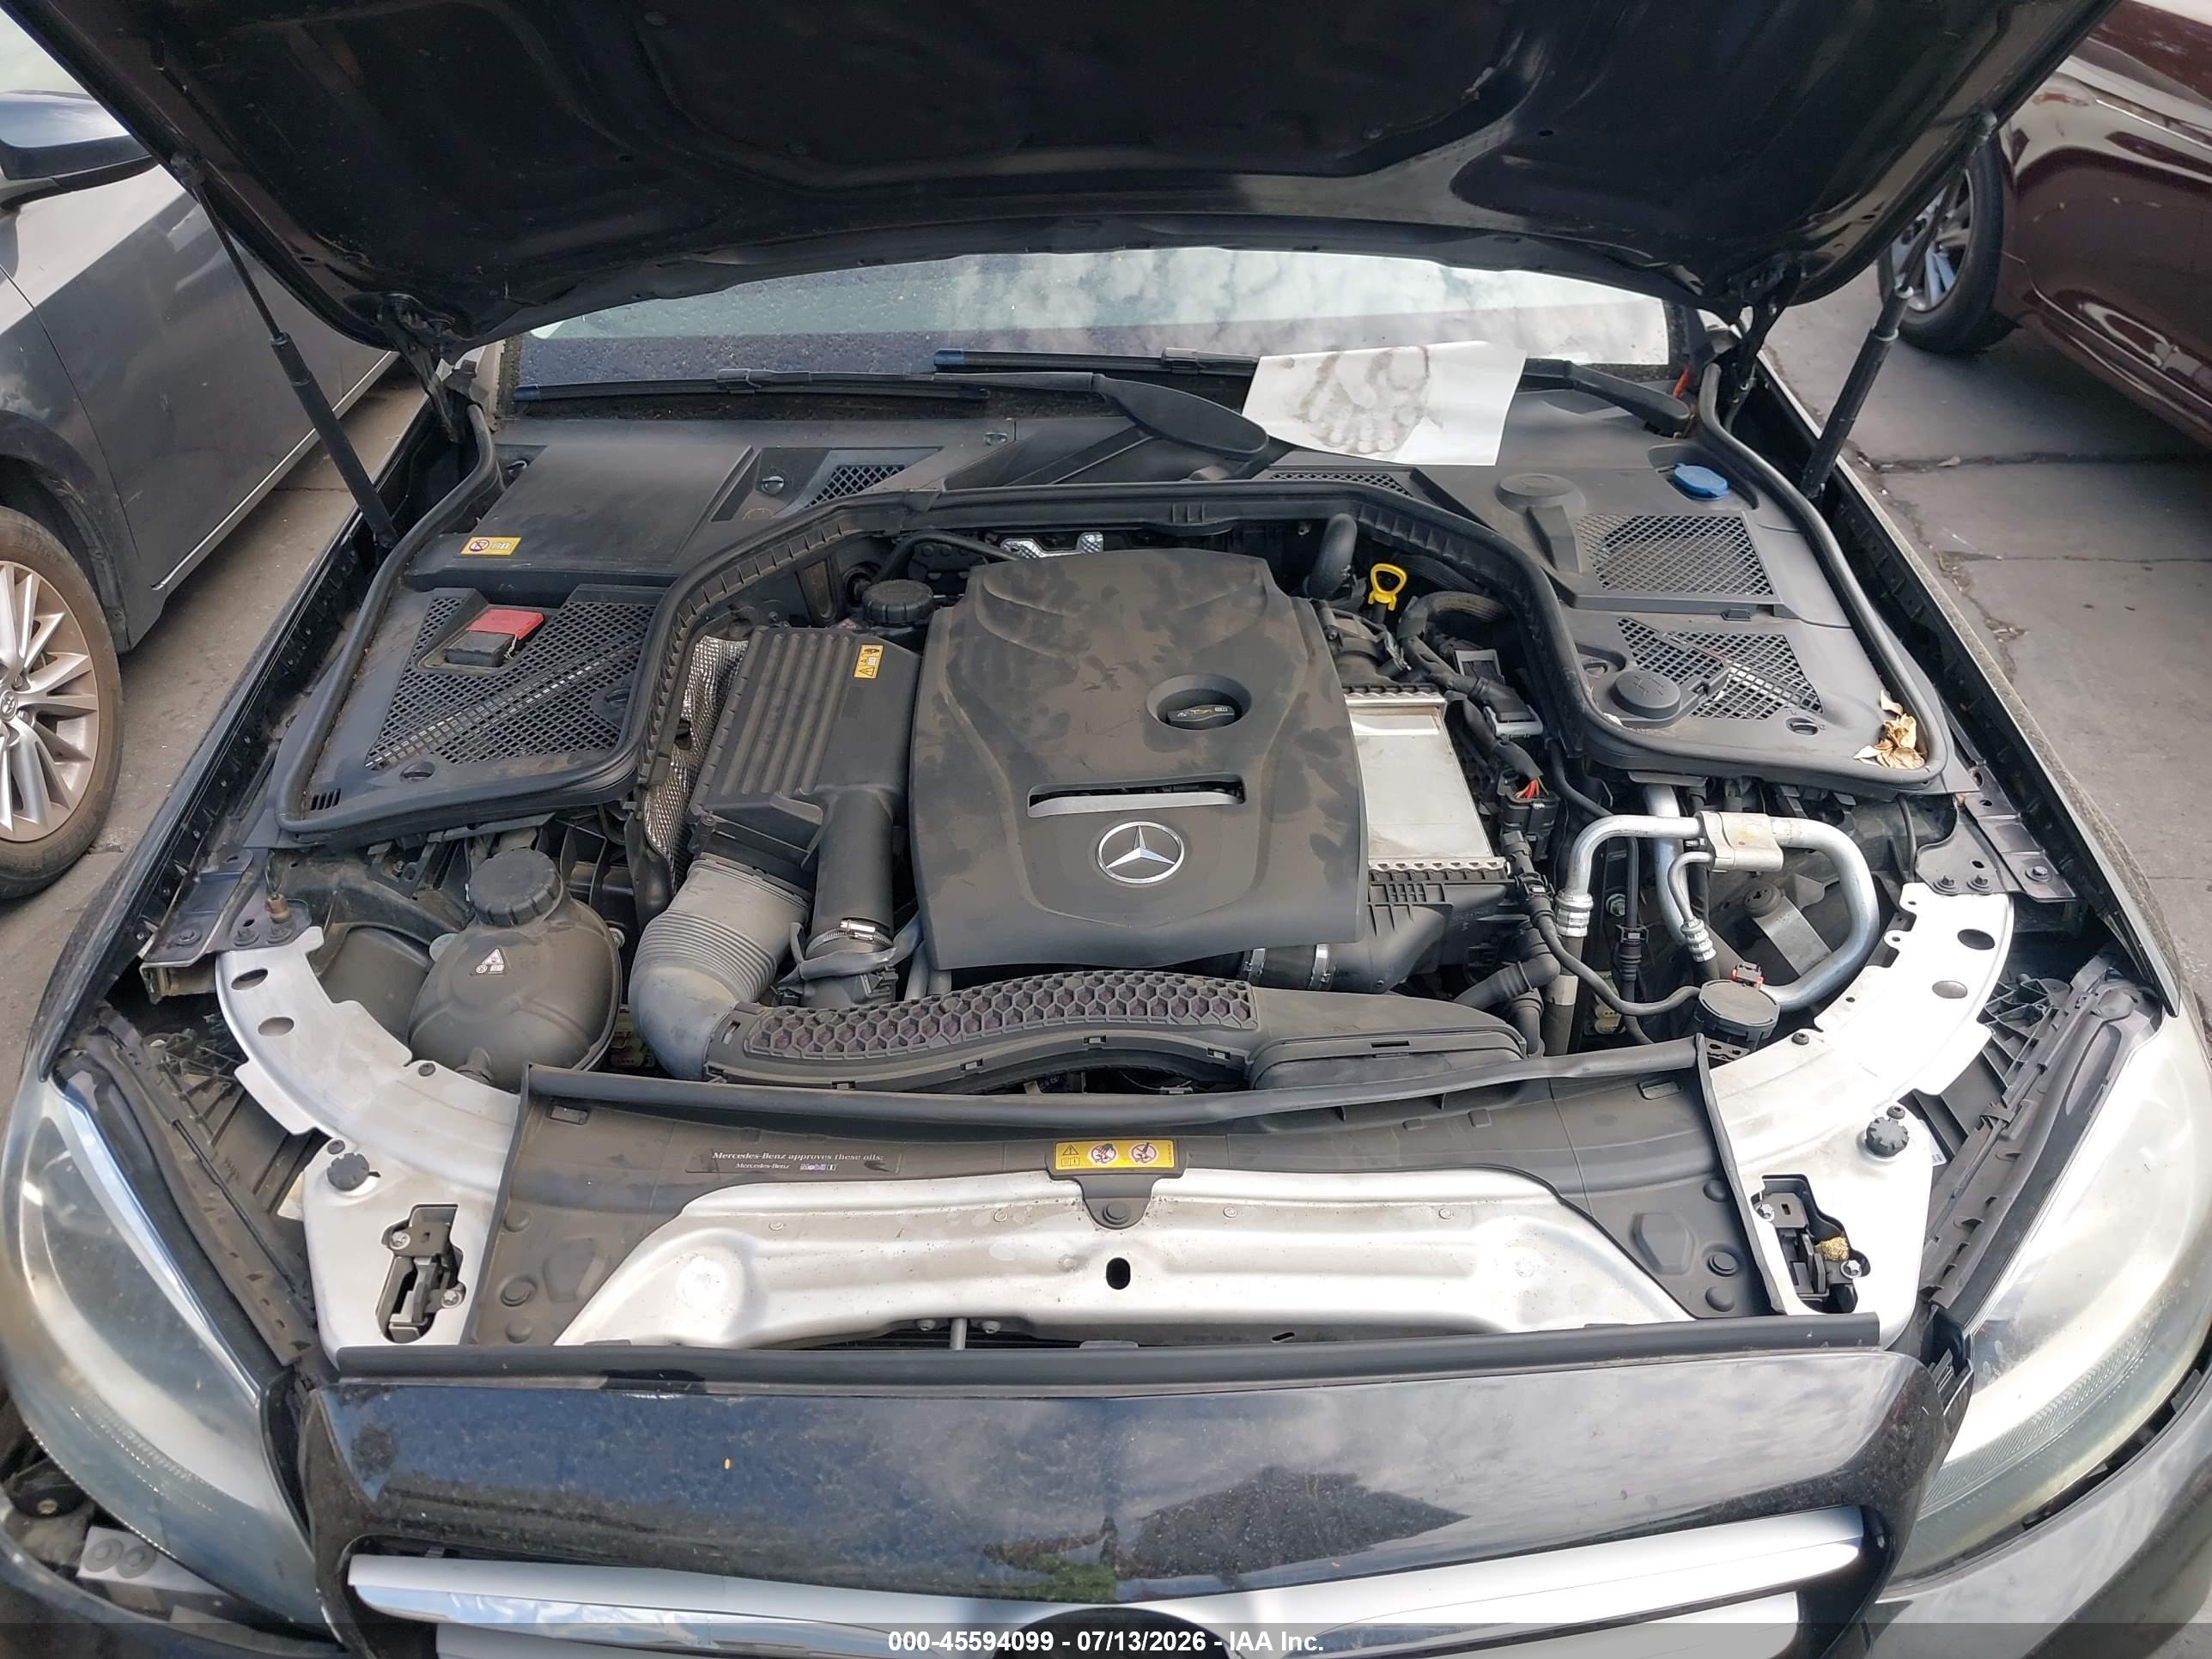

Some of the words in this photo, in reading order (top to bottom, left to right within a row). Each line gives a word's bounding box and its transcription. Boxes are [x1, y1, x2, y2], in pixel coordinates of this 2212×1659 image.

[713, 1152, 787, 1160] Mercedes-Benz
[788, 1153, 832, 1162] approves
[862, 1153, 884, 1162] oils:
